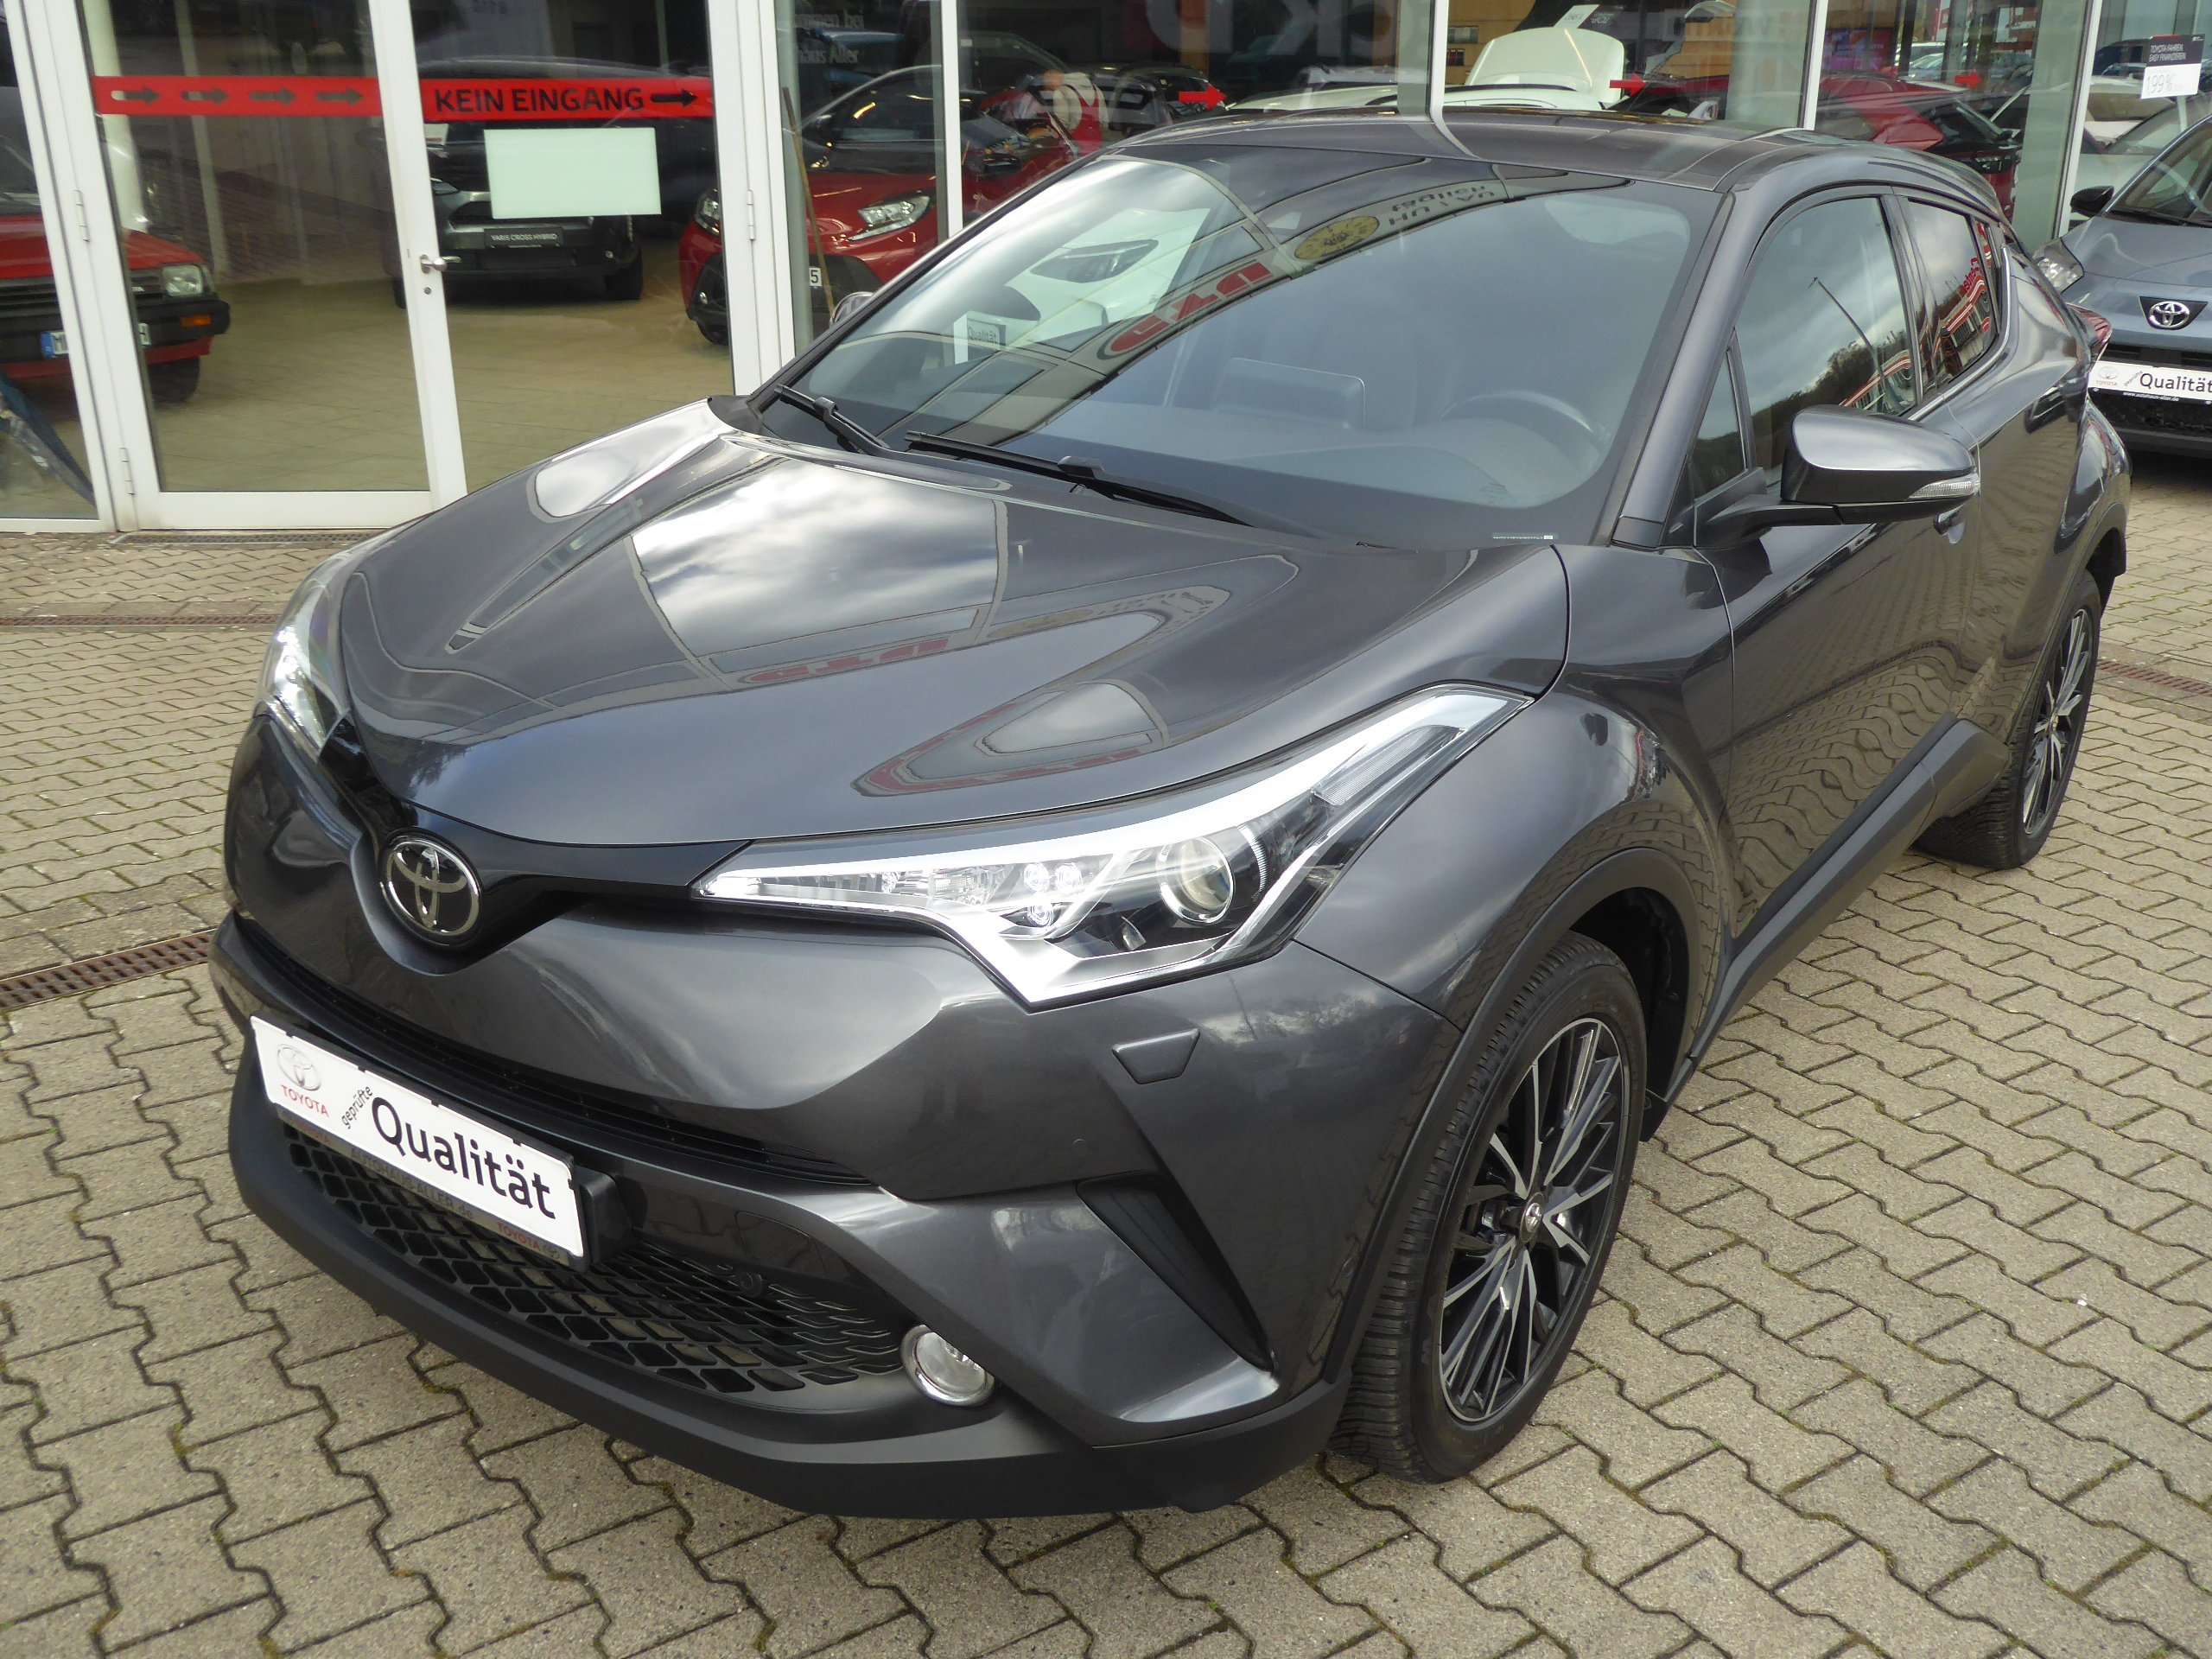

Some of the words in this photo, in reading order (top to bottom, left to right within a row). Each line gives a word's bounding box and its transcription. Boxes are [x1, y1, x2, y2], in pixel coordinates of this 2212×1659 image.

[435, 88, 505, 112] KEIN
[512, 87, 645, 112] EINGANG
[2139, 372, 2212, 394] Qualität
[280, 1084, 330, 1118] TOYOTA
[340, 1085, 374, 1130] geprüfte
[372, 1096, 556, 1220] Qualität
[497, 1221, 541, 1251] TOYOTA
